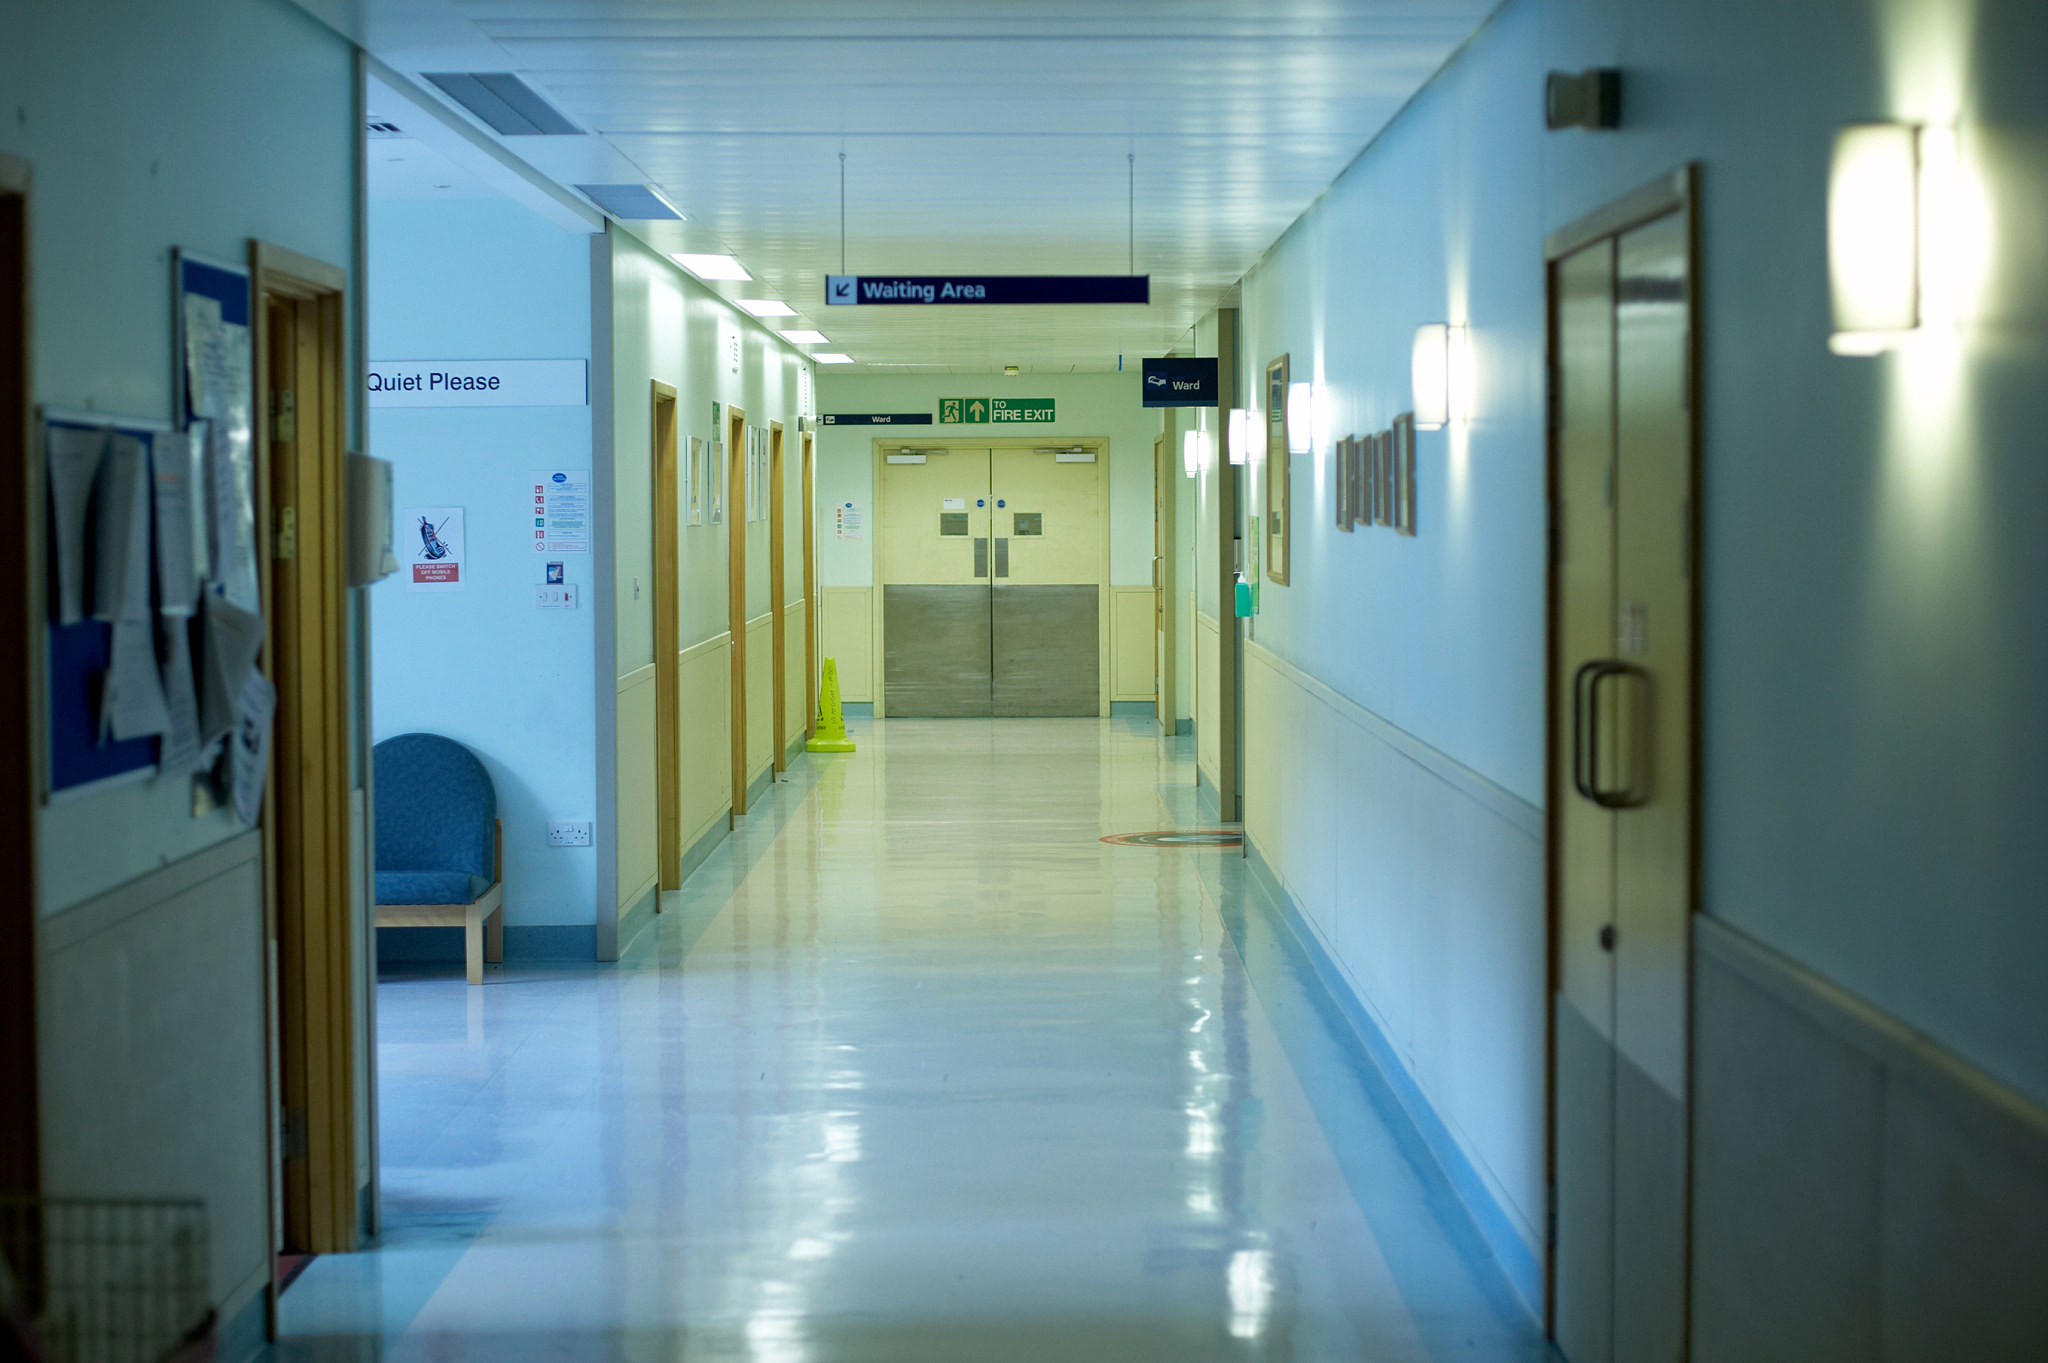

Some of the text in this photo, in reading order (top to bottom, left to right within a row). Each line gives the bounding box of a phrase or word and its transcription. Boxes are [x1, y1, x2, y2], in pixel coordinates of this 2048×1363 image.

[863, 281, 986, 302] Waiting Area
[367, 372, 500, 391] Quiet Please
[1172, 380, 1200, 390] Ward
[871, 415, 891, 423] Ward
[993, 410, 1054, 420] FIRE EXIT
